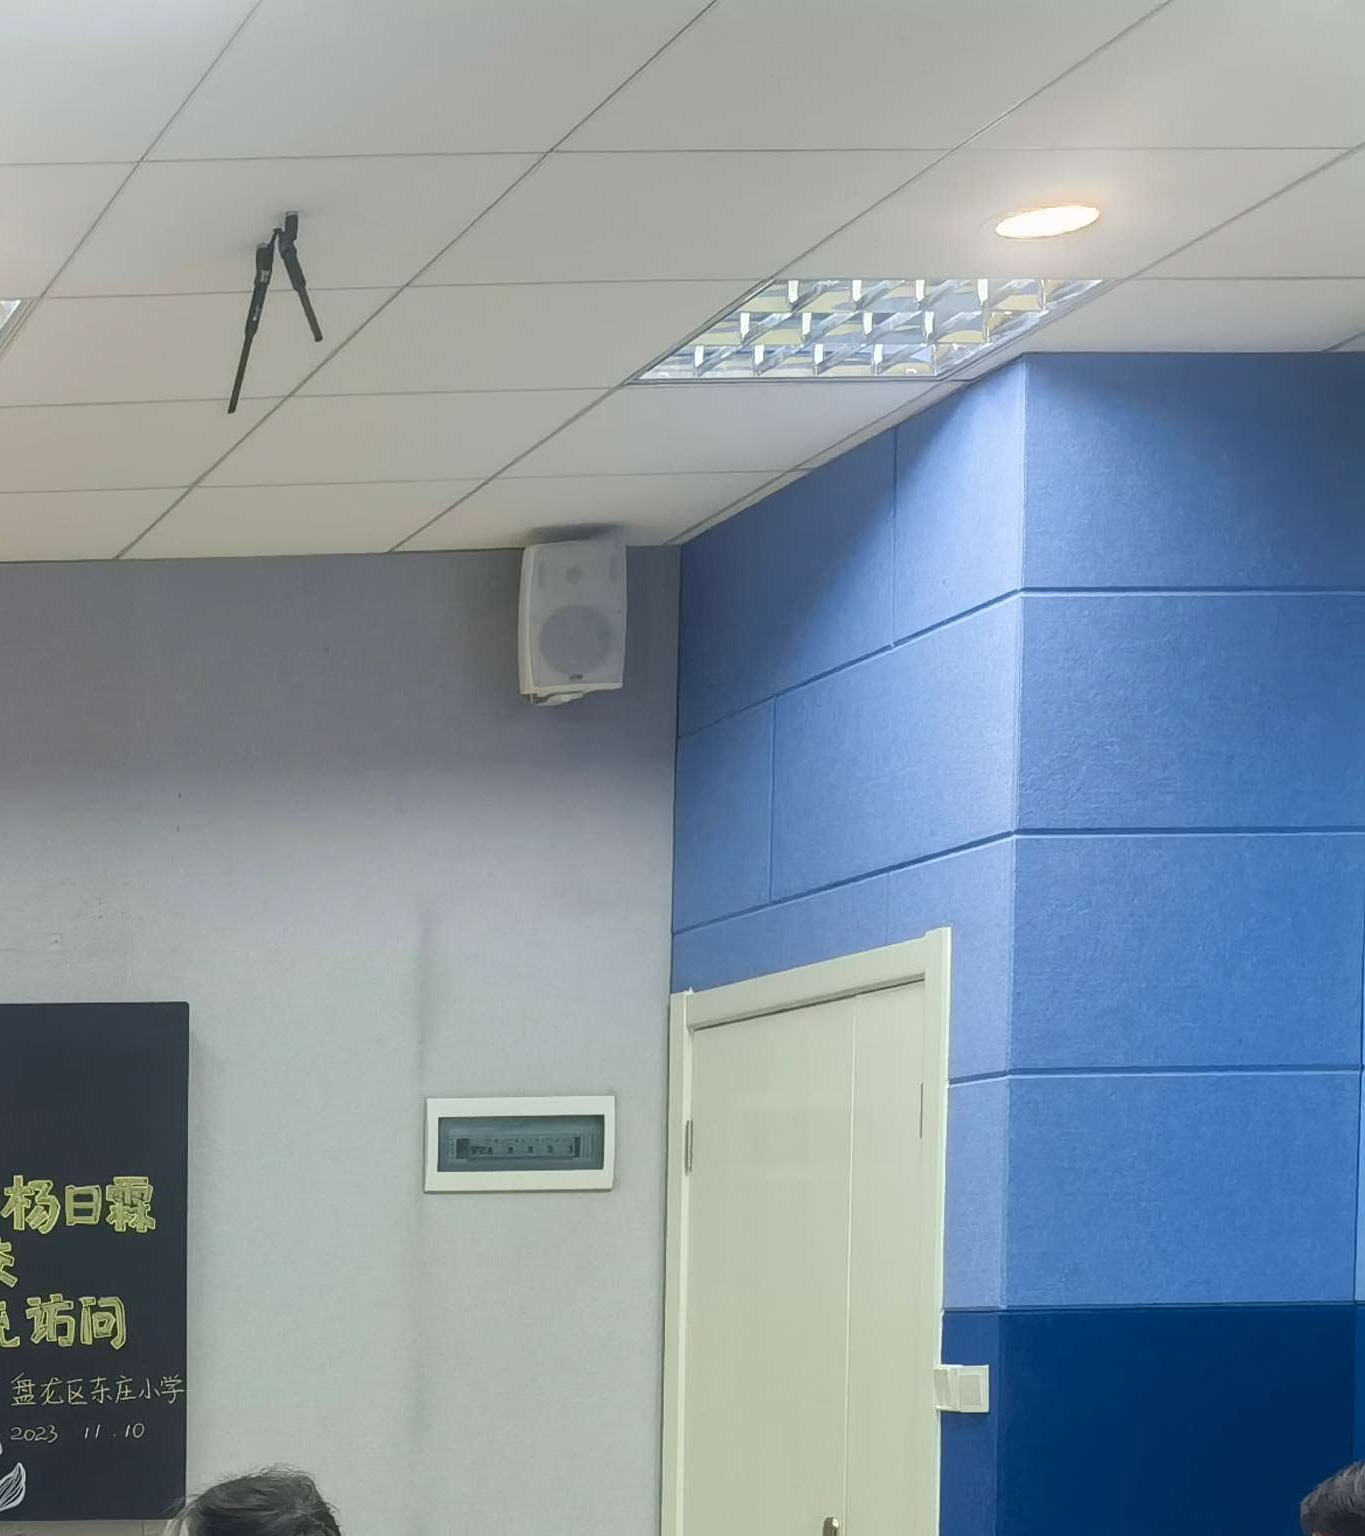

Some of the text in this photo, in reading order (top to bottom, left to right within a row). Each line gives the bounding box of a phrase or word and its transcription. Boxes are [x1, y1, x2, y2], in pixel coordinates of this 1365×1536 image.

[10, 1371, 185, 1406] 盘龙区东庄小学
[10, 1425, 59, 1443] 2023
